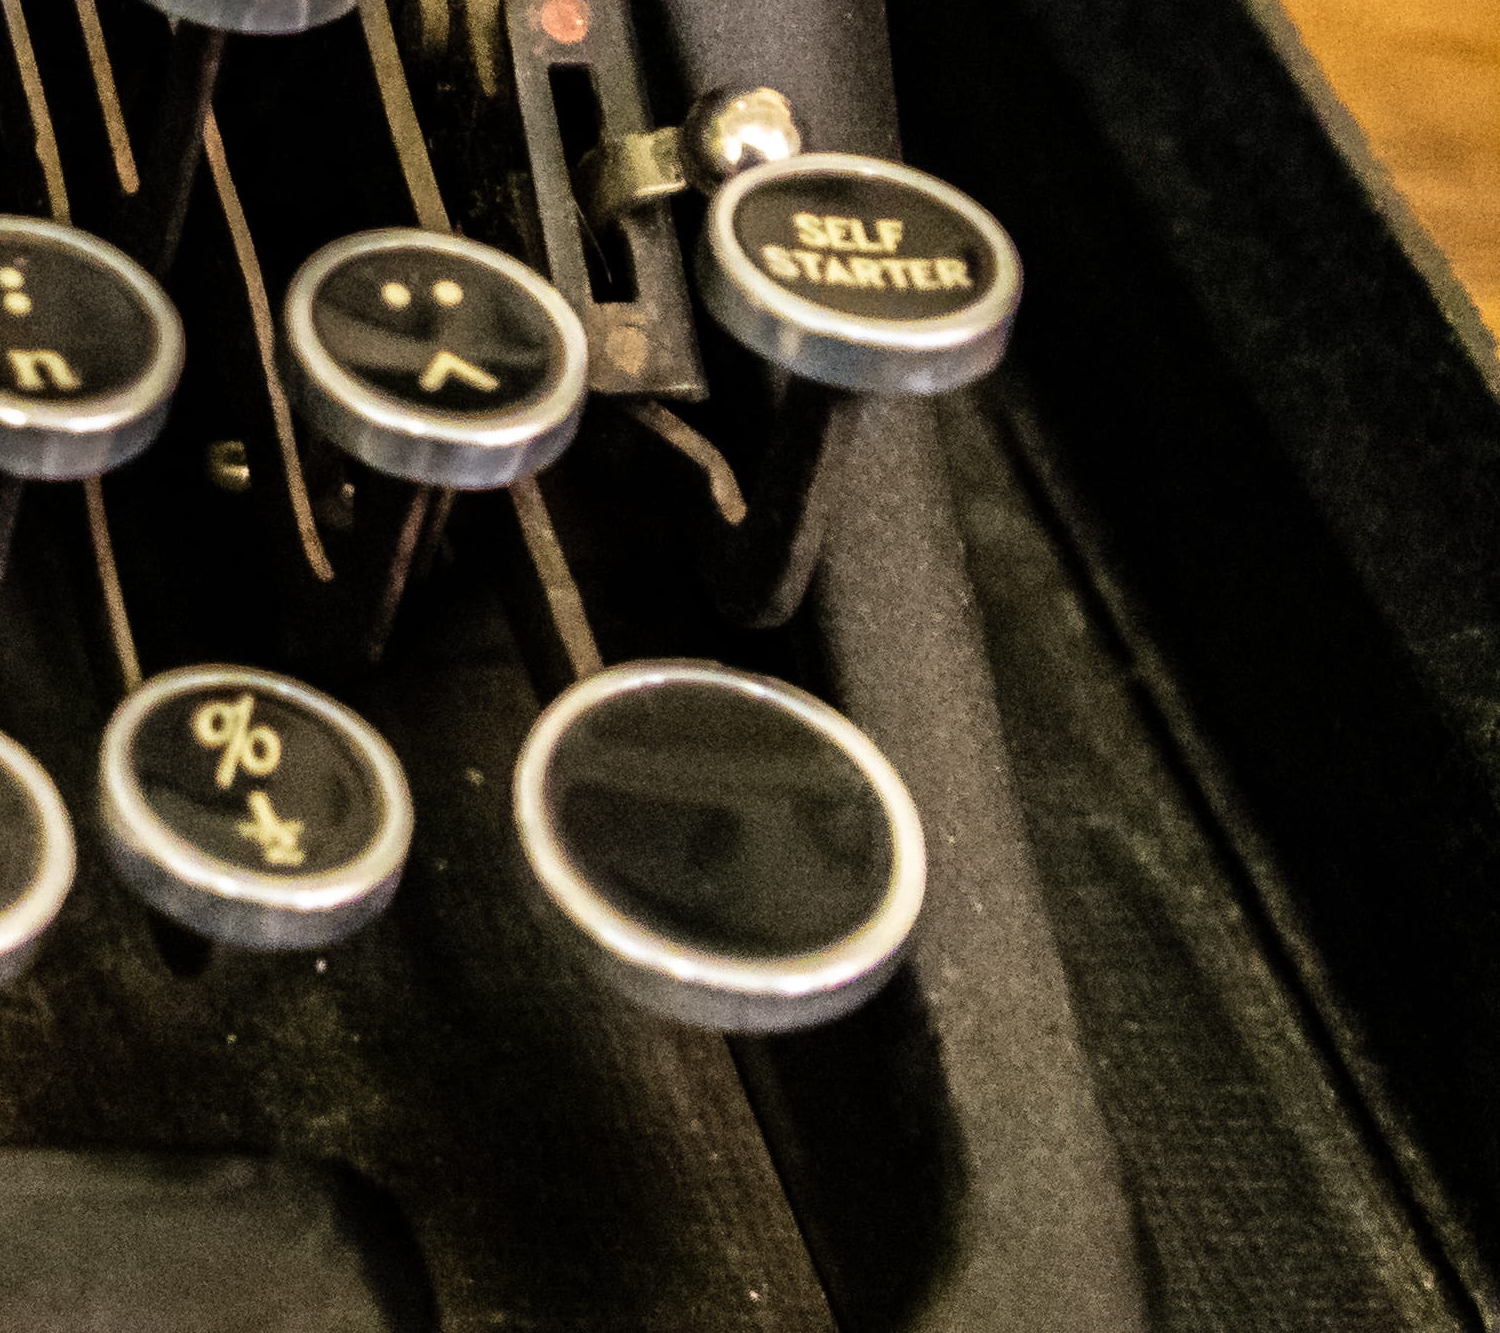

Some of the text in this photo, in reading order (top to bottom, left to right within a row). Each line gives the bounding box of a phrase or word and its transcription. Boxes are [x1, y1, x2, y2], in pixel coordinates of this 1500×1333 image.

[791, 209, 905, 258] SELF
[761, 242, 974, 294] STARTER
[192, 693, 282, 789] %
